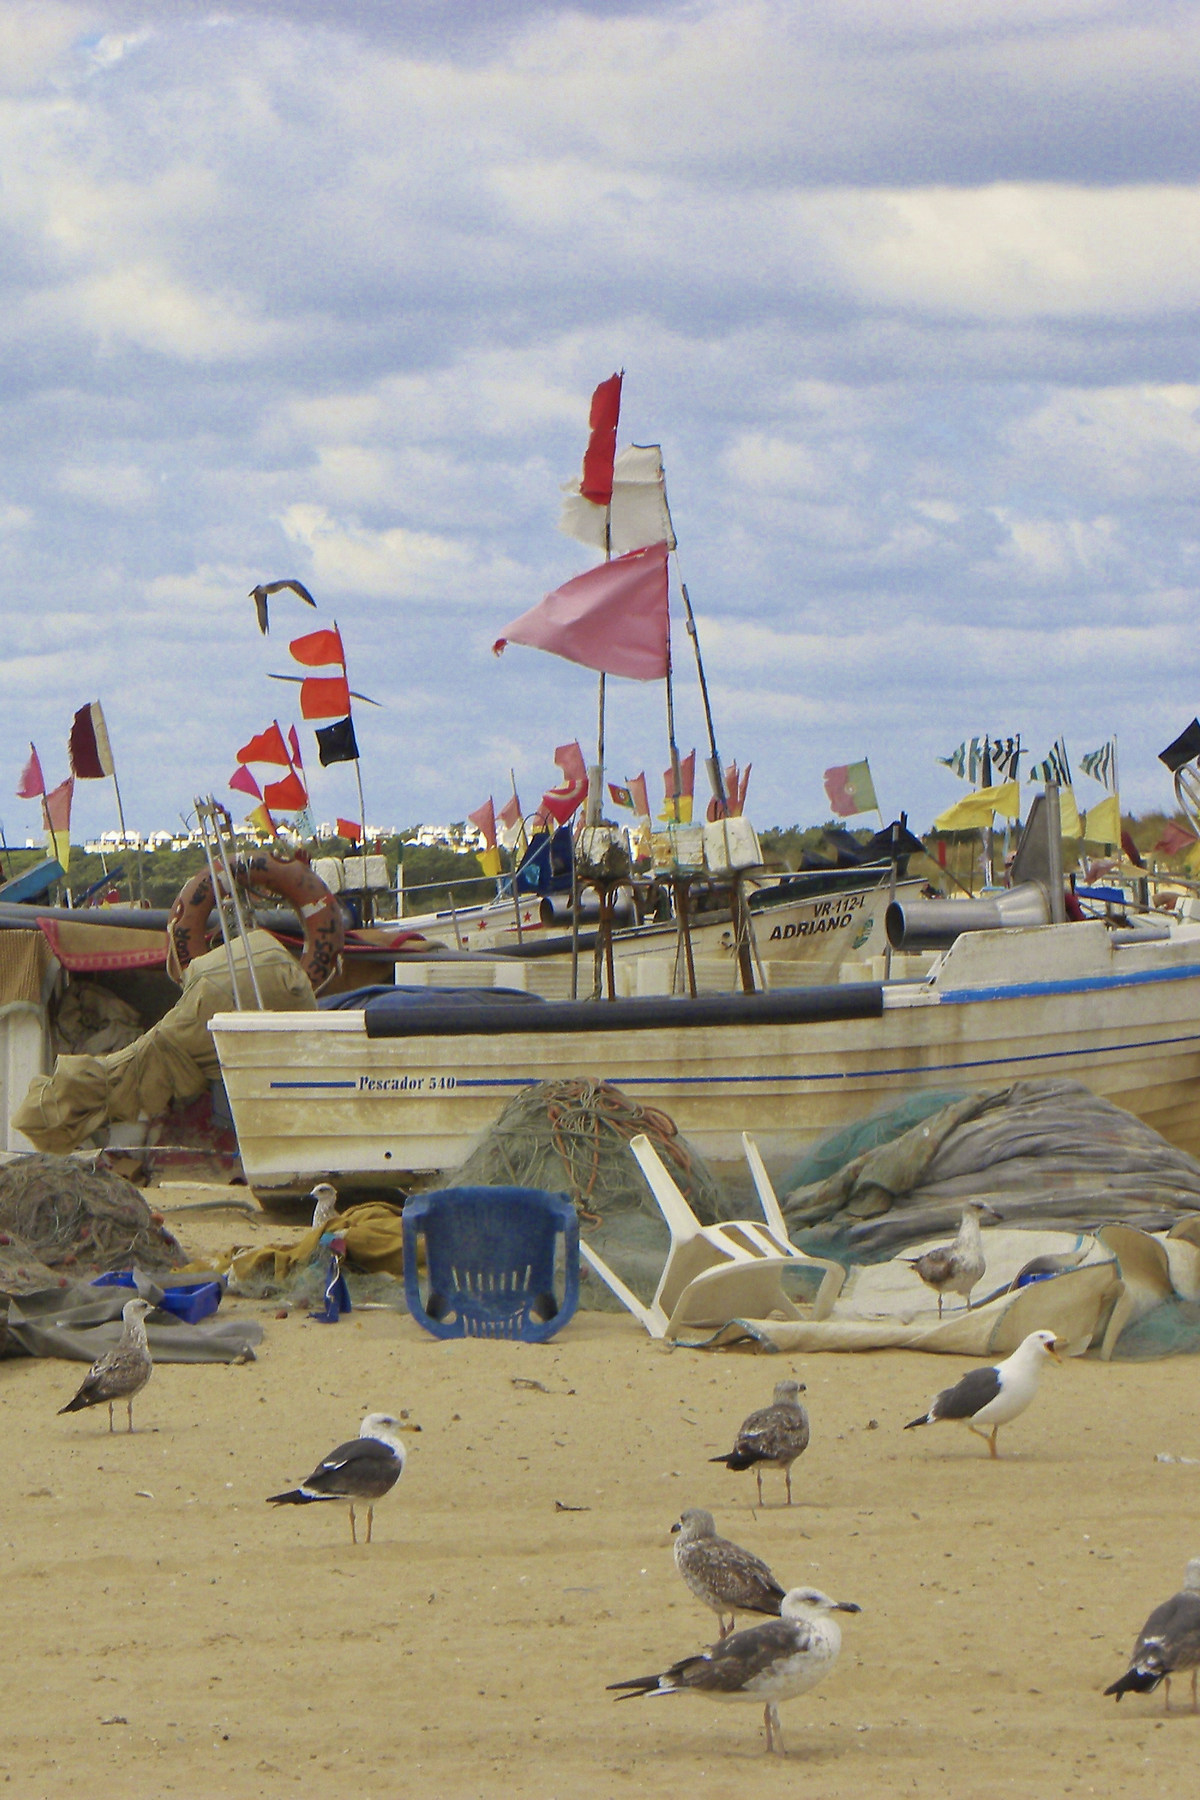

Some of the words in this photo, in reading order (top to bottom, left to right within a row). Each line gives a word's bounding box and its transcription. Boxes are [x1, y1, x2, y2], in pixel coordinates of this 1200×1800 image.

[769, 914, 852, 941] ADRIANO
[359, 1076, 425, 1090] Pescador
[429, 1077, 456, 1089] 540
